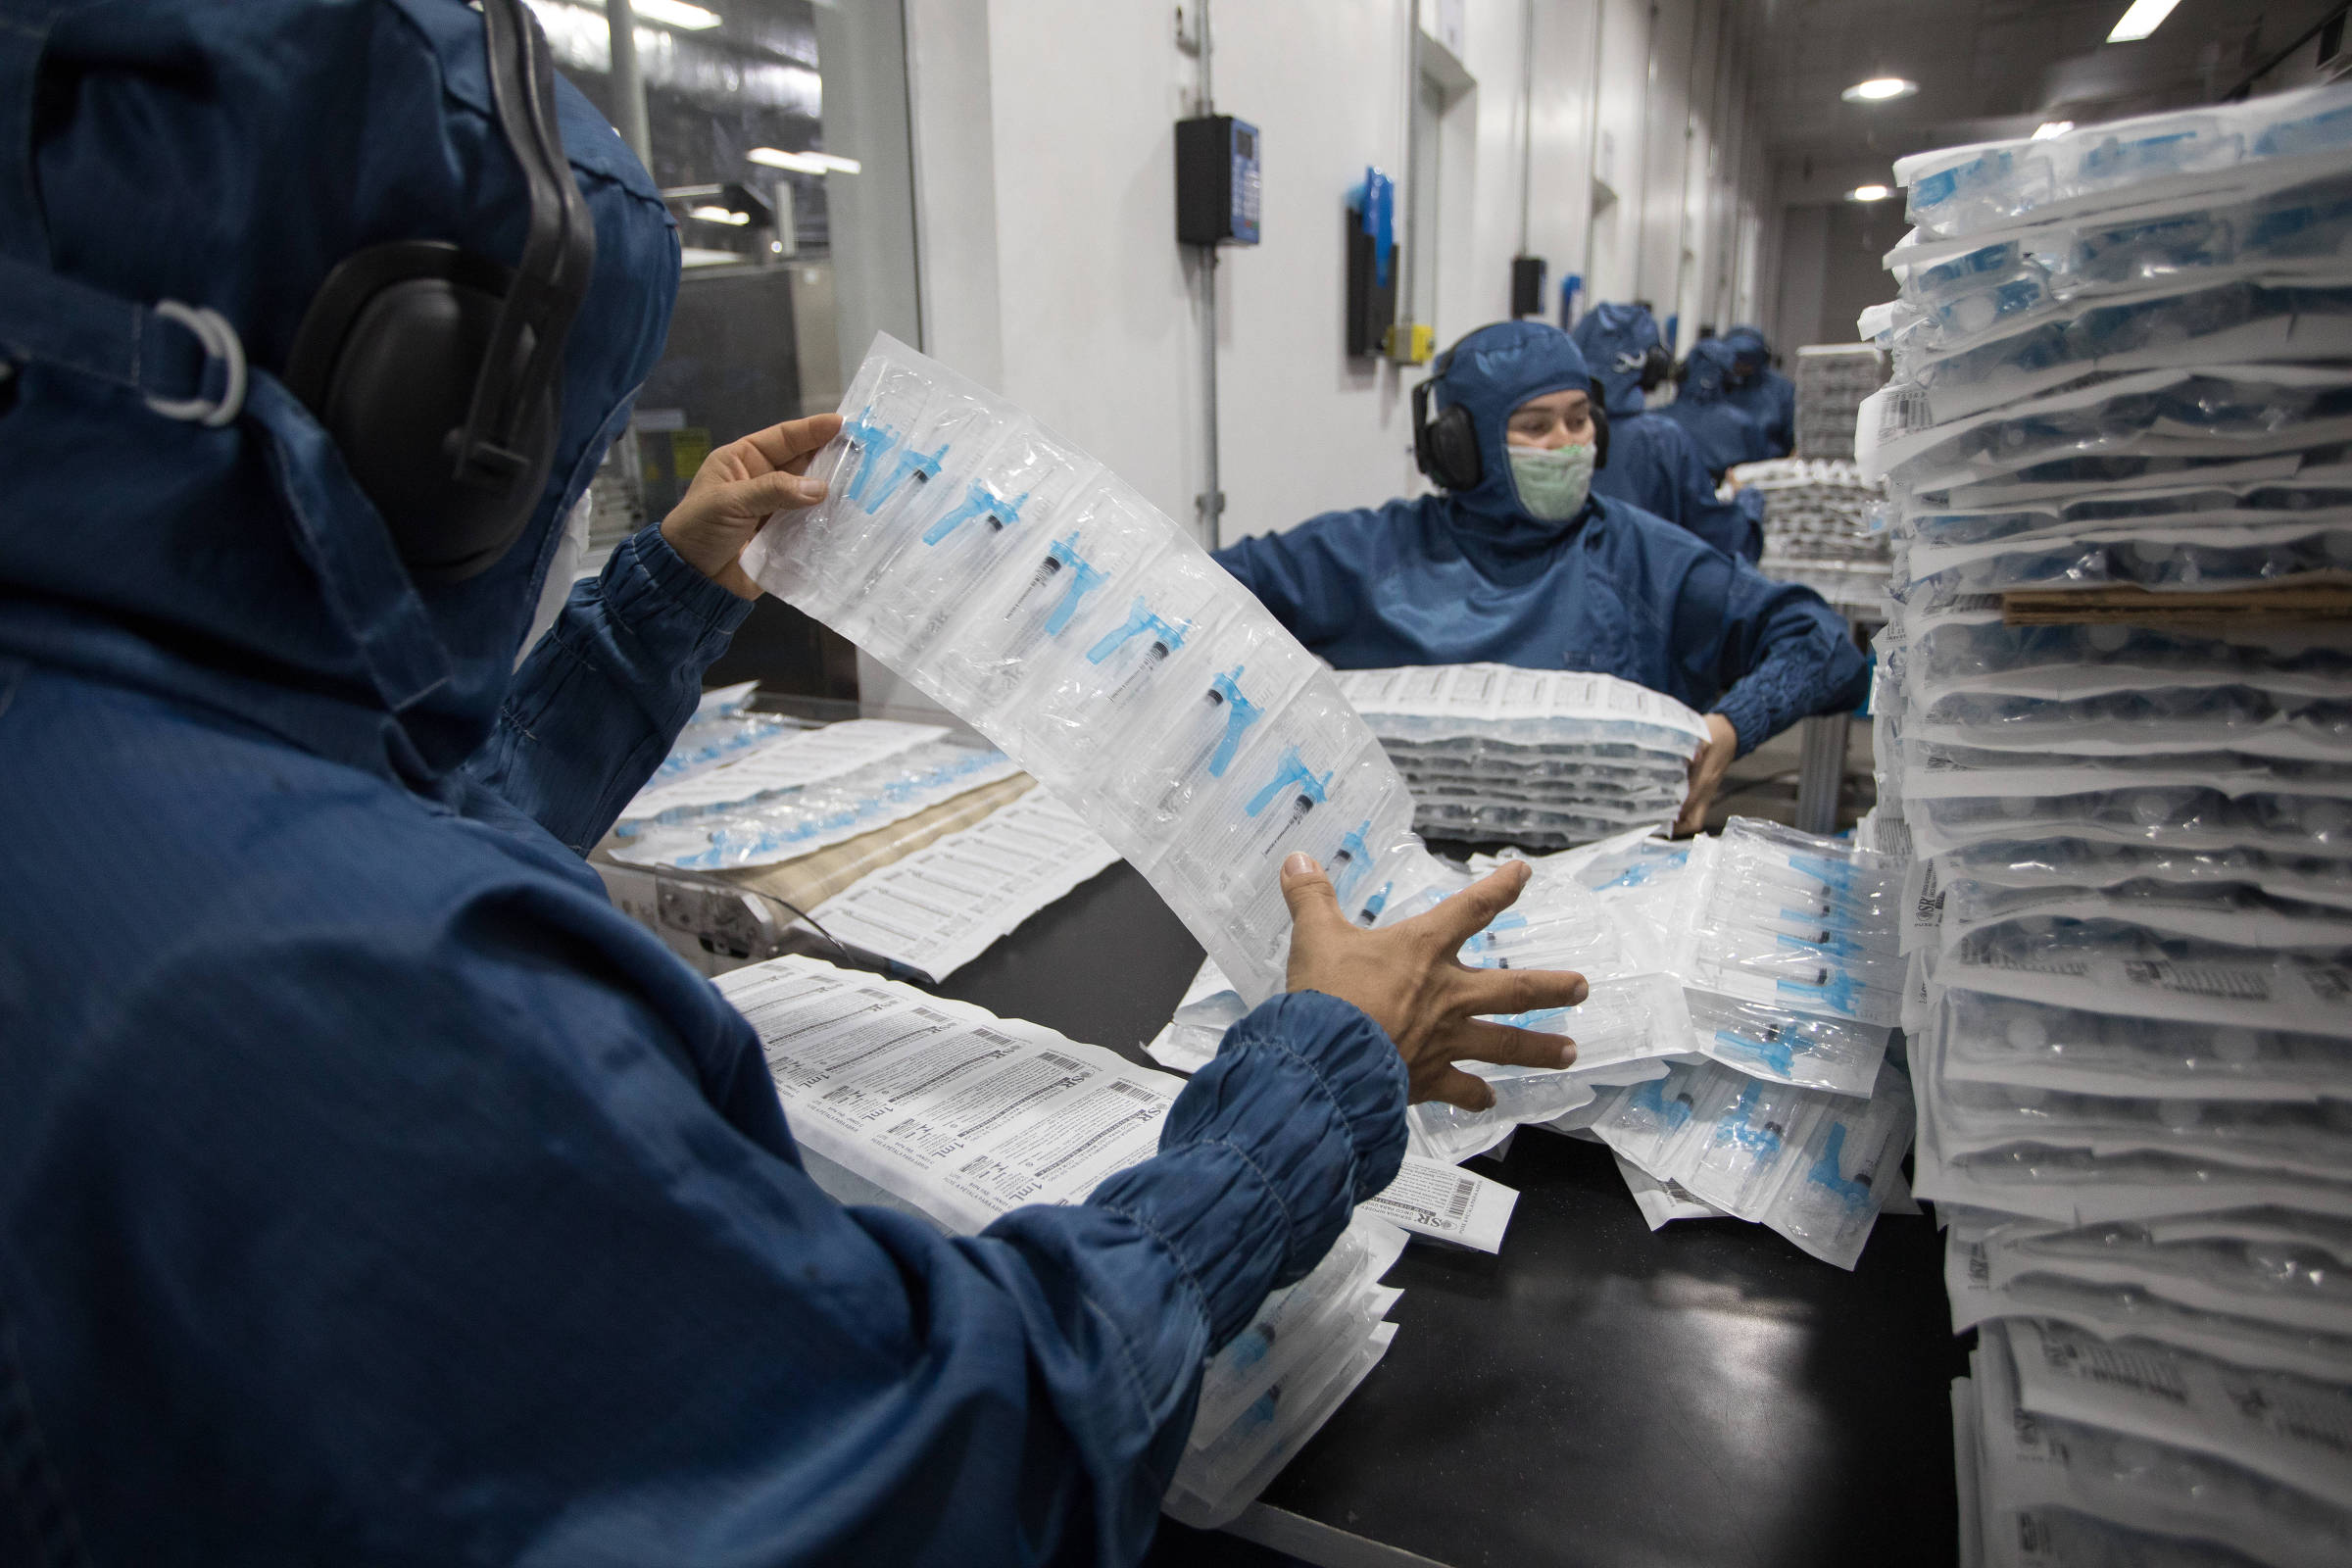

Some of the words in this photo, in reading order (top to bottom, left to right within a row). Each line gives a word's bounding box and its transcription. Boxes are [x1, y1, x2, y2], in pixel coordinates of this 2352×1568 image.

[798, 1072, 830, 1089] 1mL
[1060, 1075, 1085, 1090] SR
[861, 1106, 895, 1122] 1mL
[1138, 1107, 1161, 1123] SR
[932, 1141, 964, 1158] 1mL
[1008, 1181, 1044, 1201] 1mL
[1418, 1213, 1443, 1228] SR
